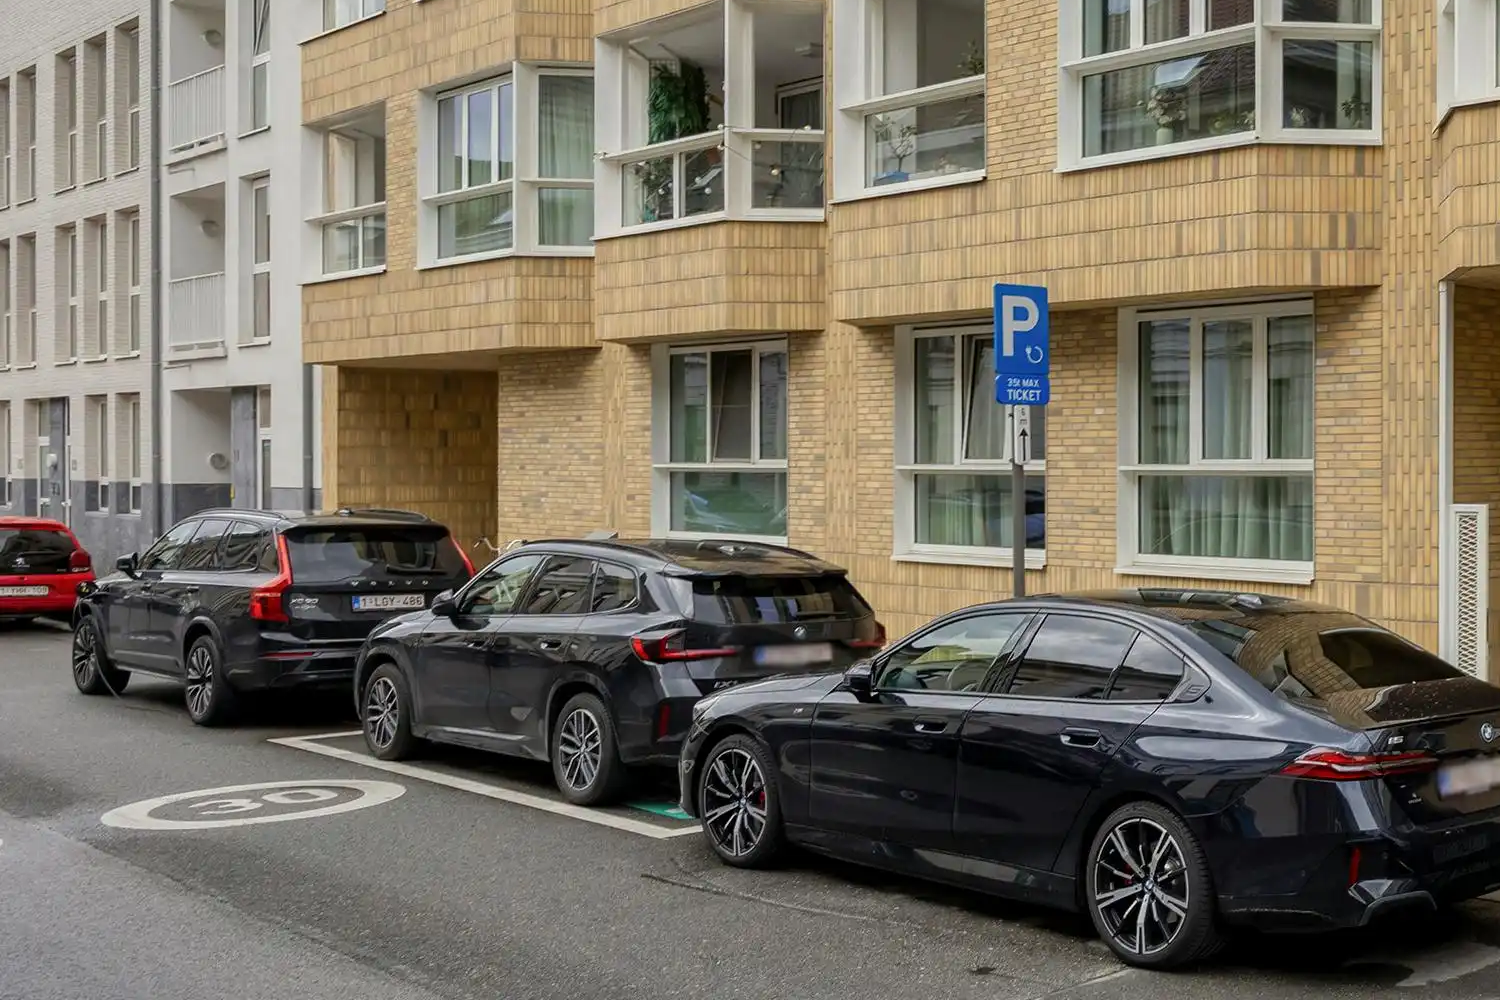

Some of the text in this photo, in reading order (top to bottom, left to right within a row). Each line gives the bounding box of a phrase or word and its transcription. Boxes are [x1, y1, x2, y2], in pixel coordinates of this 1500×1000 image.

[1002, 295, 1039, 357] P
[1022, 378, 1040, 388] MAX
[1007, 388, 1042, 401] TICKET
[188, 788, 338, 815] 30
